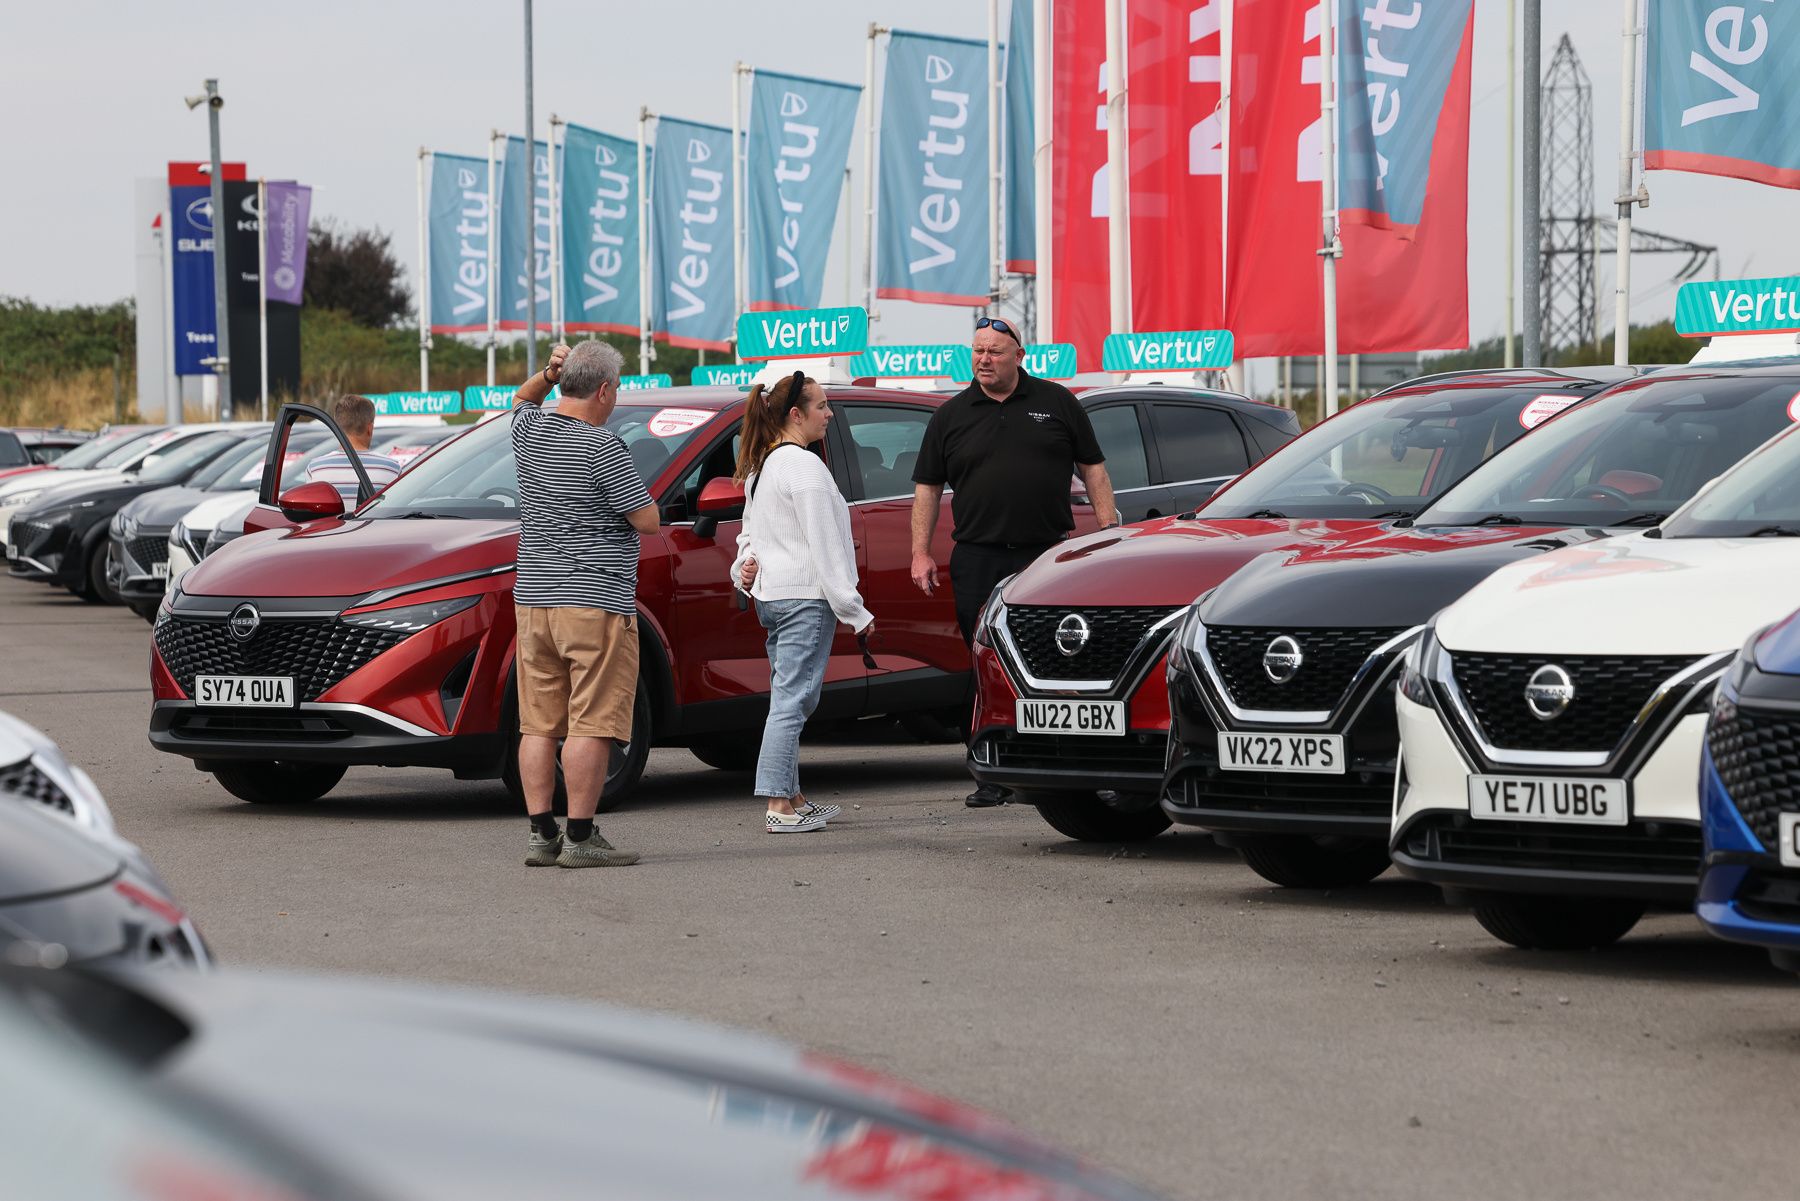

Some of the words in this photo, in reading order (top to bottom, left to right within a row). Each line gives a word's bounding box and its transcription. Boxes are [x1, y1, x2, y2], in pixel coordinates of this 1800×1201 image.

[1681, 0, 1774, 127] Ve
[1364, 0, 1422, 191] ert
[909, 88, 970, 275] Vertu
[774, 121, 819, 289] Vertu
[281, 192, 300, 266] Motability
[584, 169, 630, 311] Vertu
[666, 167, 724, 321] Vertu
[453, 190, 489, 316] Vertu
[762, 317, 837, 349] Vertu
[873, 349, 942, 372] Vertu
[1127, 338, 1202, 364] Vertu
[400, 394, 444, 413] Vertu
[1266, 656, 1297, 665] NISSAN
[202, 679, 246, 702] SY74
[251, 680, 285, 703] OUA
[1529, 688, 1567, 698] NISSAN
[1023, 703, 1072, 729] NU22
[1077, 704, 1116, 730] GBX
[1226, 736, 1283, 765] VK22
[1289, 738, 1334, 767] XPS
[1485, 781, 1545, 814] YE71
[1553, 783, 1608, 817] UBG
[563, 847, 609, 861] adidas
